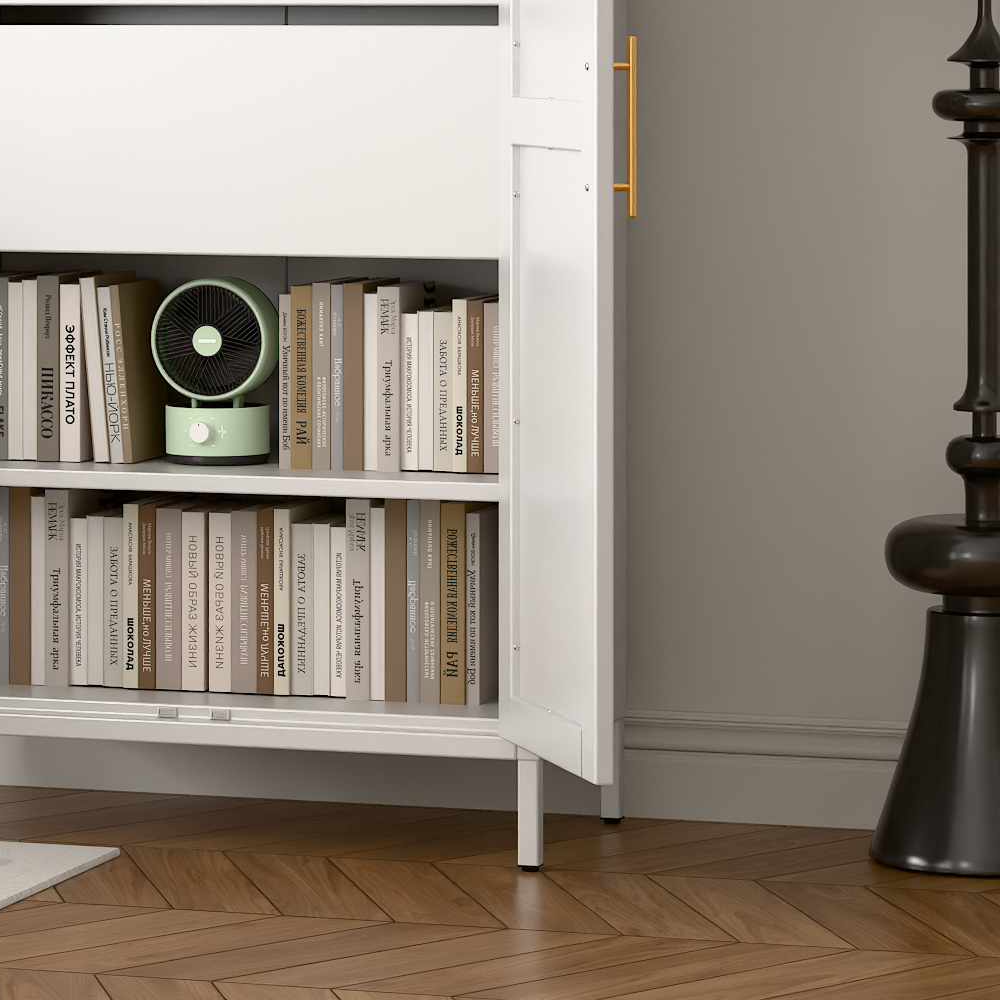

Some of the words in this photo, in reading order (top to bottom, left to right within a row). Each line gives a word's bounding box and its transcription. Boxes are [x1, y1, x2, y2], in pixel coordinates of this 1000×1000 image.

[380, 298, 389, 335] РЕМАРК
[65, 324, 75, 377] ЭФФЕКТ
[296, 309, 307, 372] БОЖЕСТВЕННАЯ
[438, 340, 447, 376] ЗАБОТА
[282, 346, 290, 380] Уличный
[332, 358, 342, 407] Избранное
[41, 367, 53, 439] ПИКАССО
[65, 382, 75, 425] ПЛАТО
[104, 363, 121, 443] НЬЮ-ЙОРК
[117, 358, 129, 431] ЭЛЛЕНХОРН
[295, 375, 307, 413] КОМЕДИЯ
[383, 360, 393, 431] Триумфальная
[296, 421, 310, 445] РАЙ
[438, 390, 447, 451] ПРЕДАННЫХ
[455, 406, 463, 456] ШОКОЛАД
[471, 425, 479, 457] ЛУЧШЕ
[282, 435, 290, 450] Боб
[383, 435, 391, 456] арка
[48, 502, 57, 540] РЕМАРК
[109, 546, 118, 585] ЗАБОТА
[188, 536, 199, 578] НОВЫЙ
[50, 568, 61, 643] Триумфальная
[109, 589, 118, 597] О
[188, 583, 197, 620] ОБРАЗ
[109, 600, 118, 666] ПРЕДАННЫХ
[126, 618, 134, 670] ШОКОЛАД
[188, 624, 197, 668] ЖИЗНИ
[50, 648, 59, 670] арка
[142, 638, 151, 672] ЛУЧШЕ
